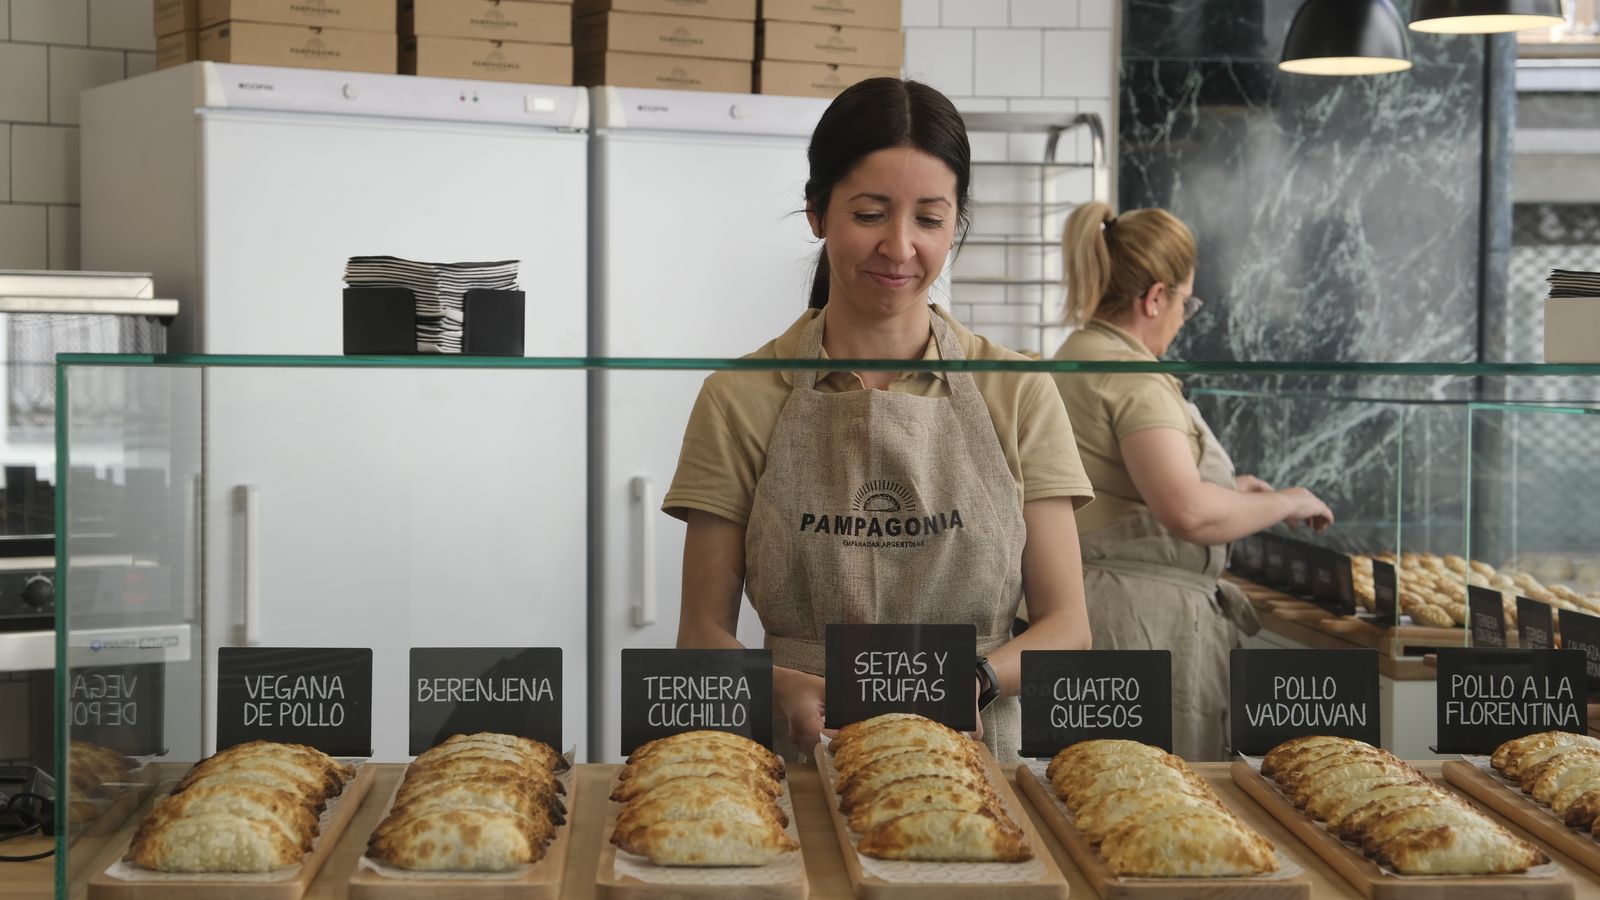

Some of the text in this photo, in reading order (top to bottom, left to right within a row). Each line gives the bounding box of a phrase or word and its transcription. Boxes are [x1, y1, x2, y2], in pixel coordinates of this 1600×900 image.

[800, 509, 964, 537] PAMPAGONIA
[855, 651, 948, 676] SETAS Y
[244, 674, 345, 700] VEGANA
[417, 677, 554, 702] BERENJENA
[643, 675, 751, 700] TERNERA
[857, 678, 946, 703] TRUFAS
[1053, 677, 1140, 702] CUATRO
[1274, 676, 1337, 700] POLLO
[1451, 674, 1574, 699] POLLO A LA
[243, 703, 345, 727] DE POLLO
[648, 703, 747, 727] CUCHILLO
[1050, 705, 1143, 729] QUESOS
[1245, 703, 1367, 727] VADOUVAN
[1446, 702, 1580, 726] FLORENTINA
